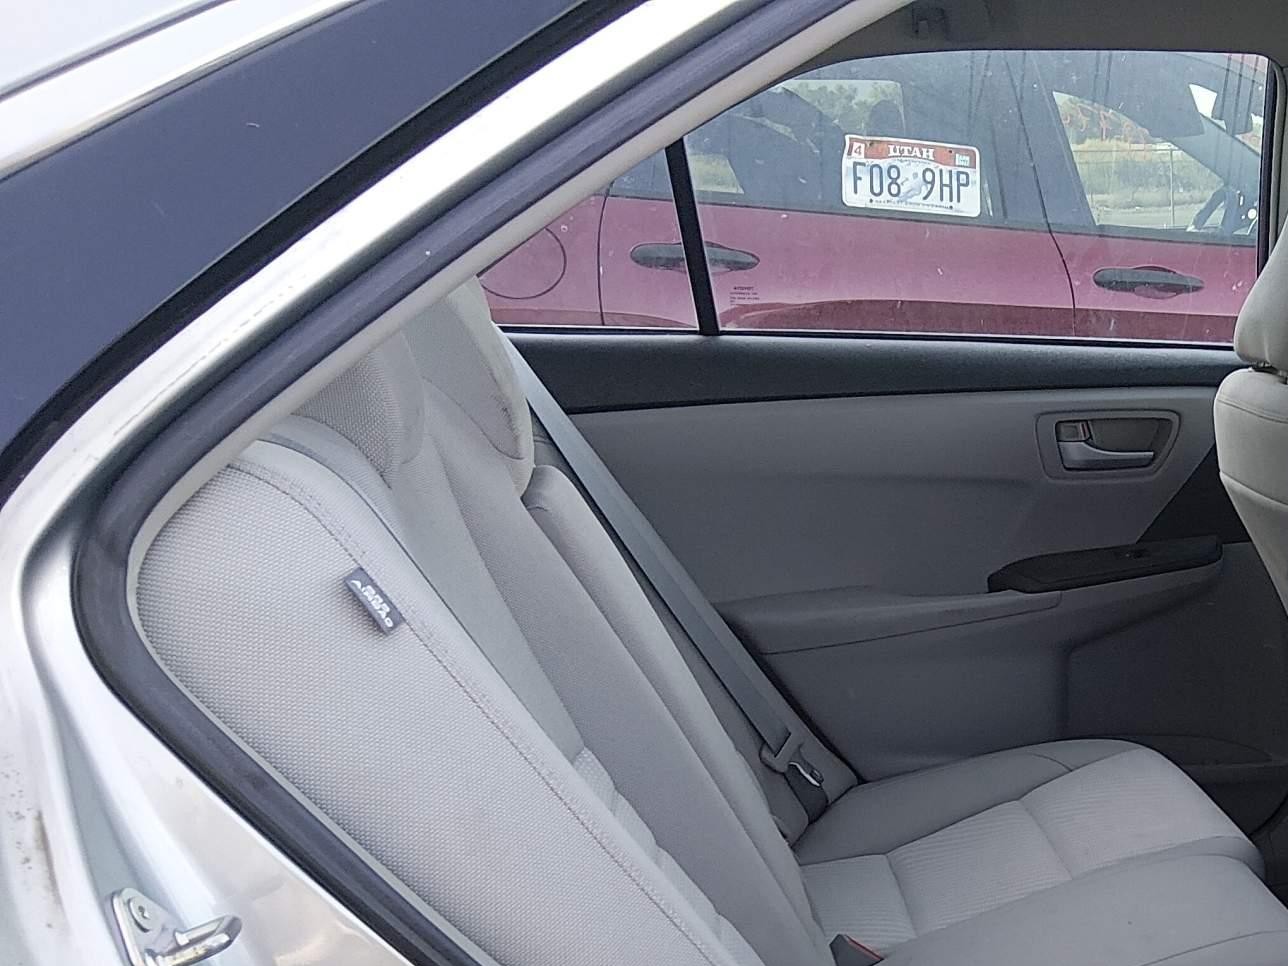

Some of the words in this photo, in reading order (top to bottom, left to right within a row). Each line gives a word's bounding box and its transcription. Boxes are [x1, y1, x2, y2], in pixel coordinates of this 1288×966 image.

[887, 144, 935, 161] UTAH
[852, 161, 902, 198] F08
[921, 167, 970, 204] 9HP
[350, 580, 394, 628] AIRBAG
